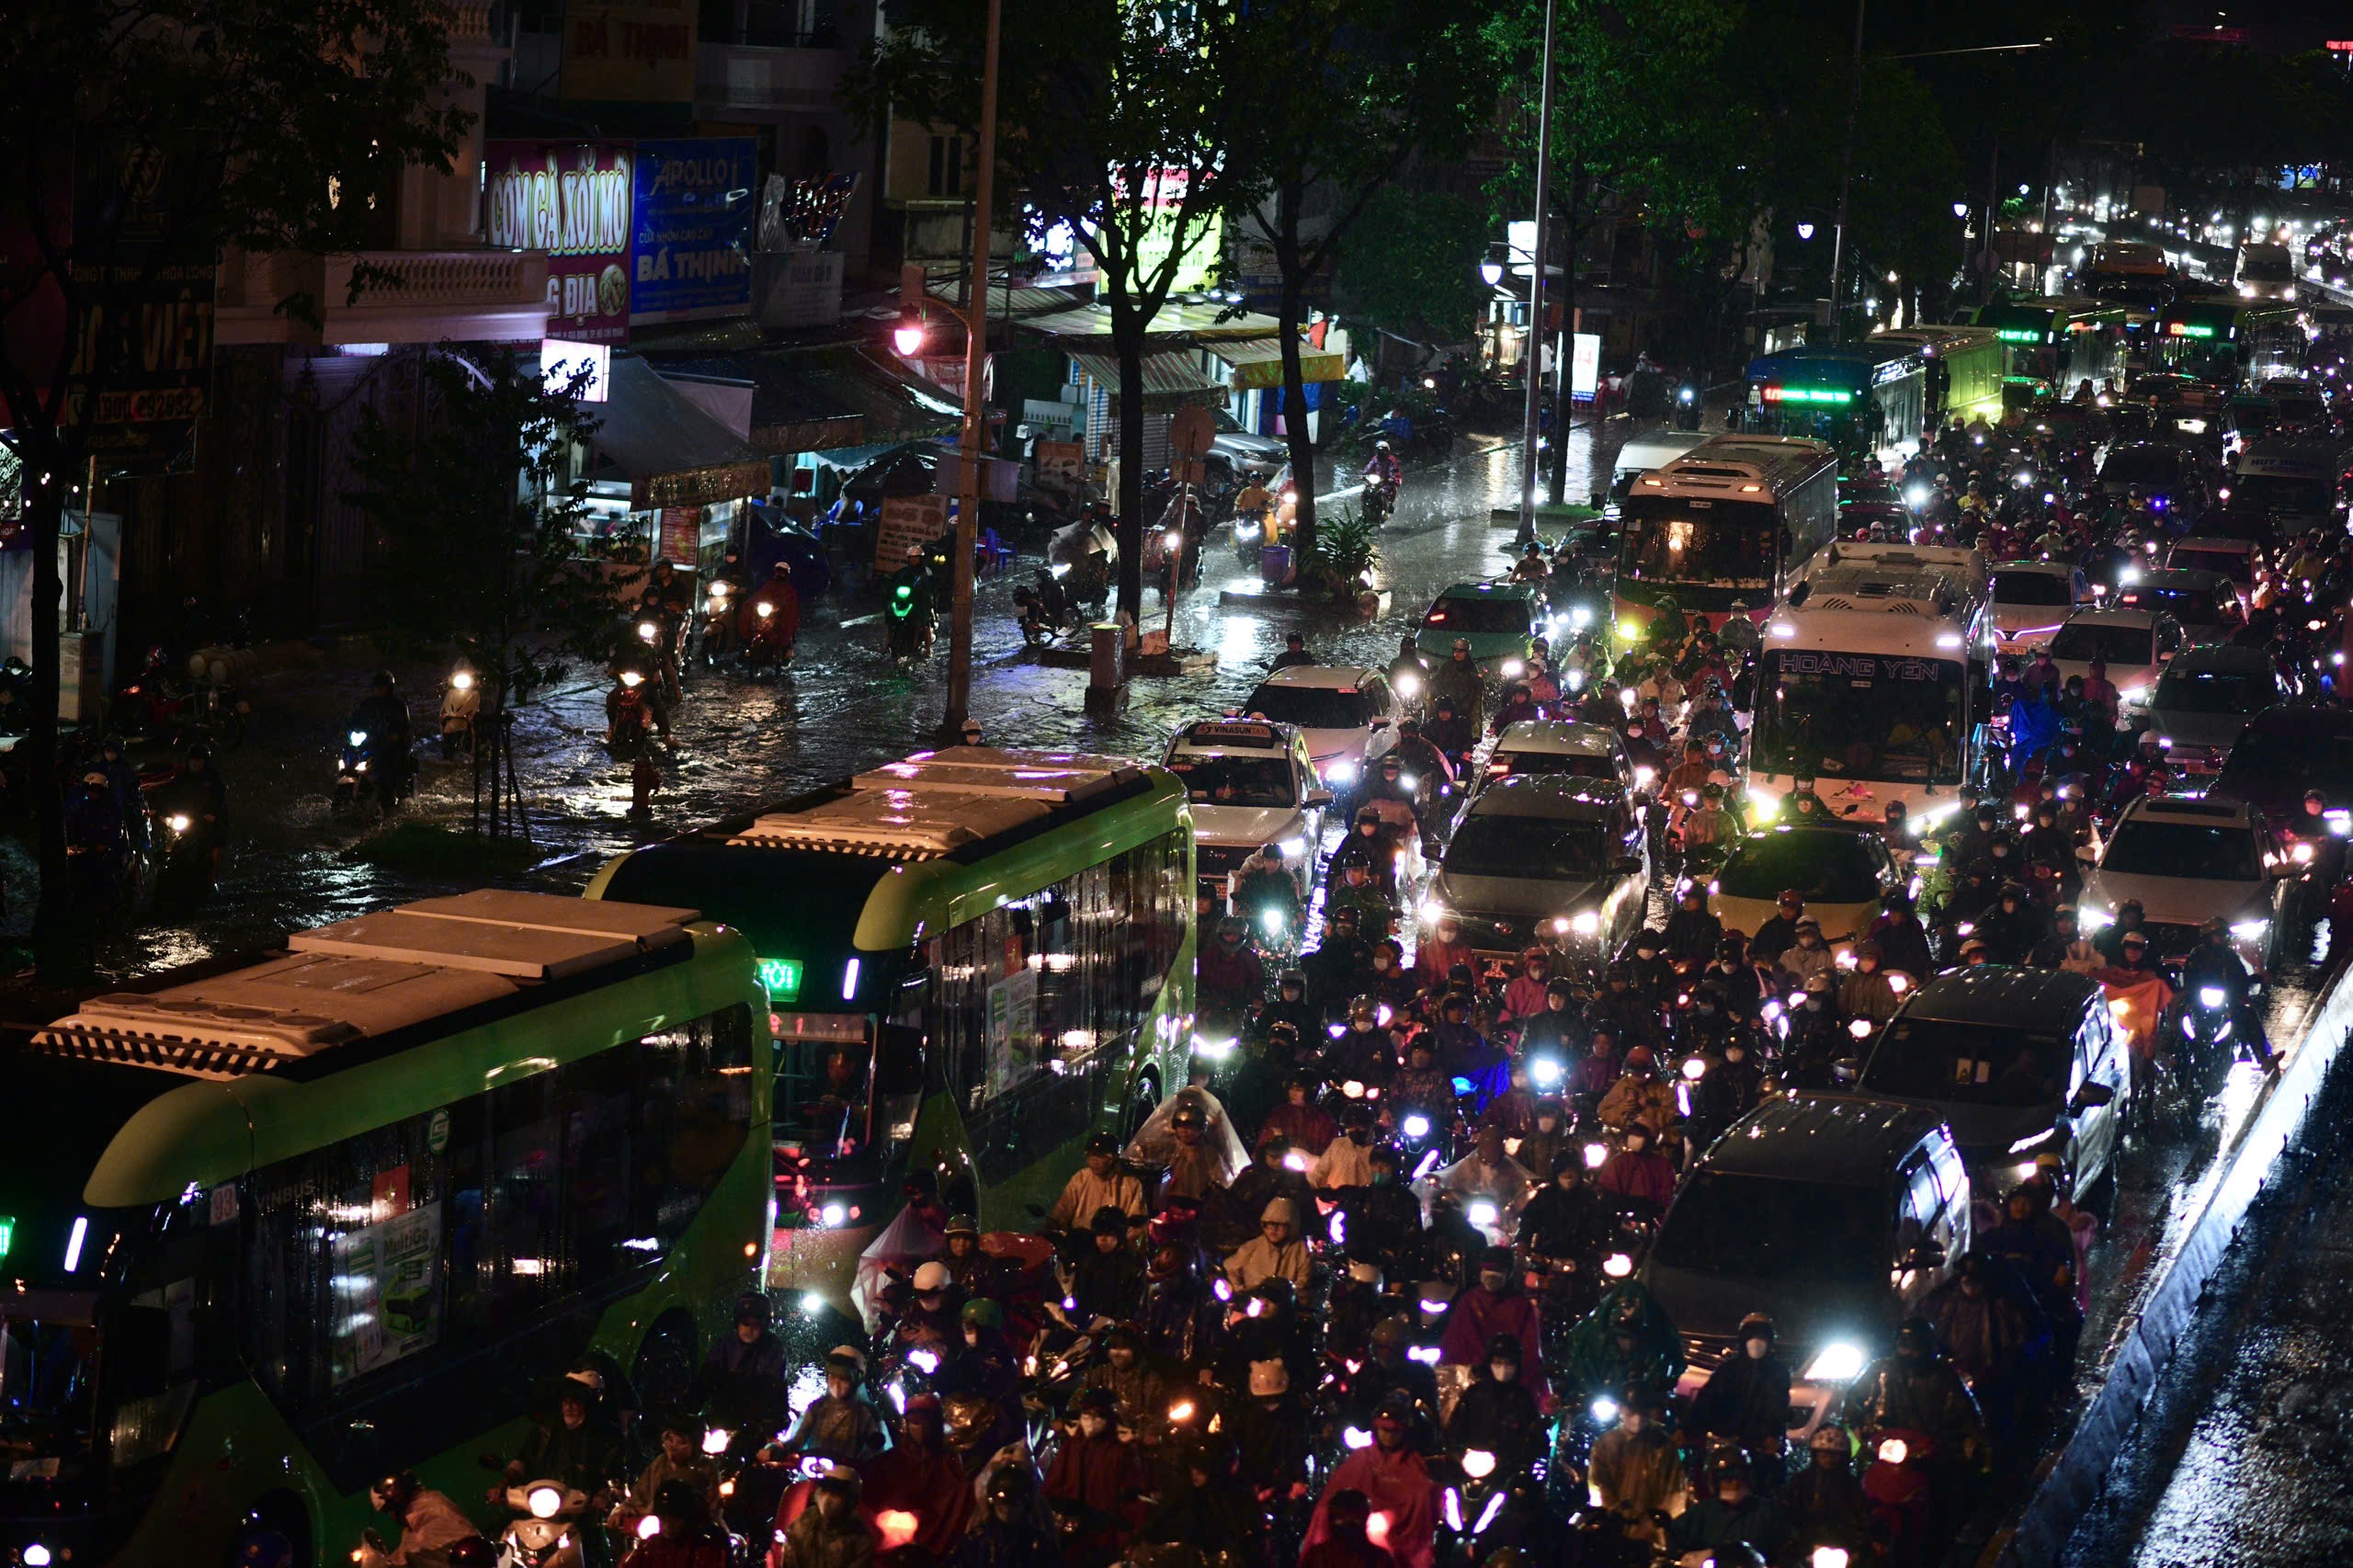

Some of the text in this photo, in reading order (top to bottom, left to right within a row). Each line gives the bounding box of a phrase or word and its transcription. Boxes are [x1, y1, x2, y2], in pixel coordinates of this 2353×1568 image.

[490, 155, 531, 250] CƠM
[533, 149, 562, 250] GÀ
[186, 264, 214, 280] LONG
[637, 246, 746, 284] BÁ THỊNH
[564, 274, 597, 327] ĐỊA
[142, 287, 213, 386] VIỆT
[1779, 652, 1876, 677] HOÀNG
[256, 1179, 314, 1210] VINBUS
[384, 1227, 429, 1256] MultiGo
